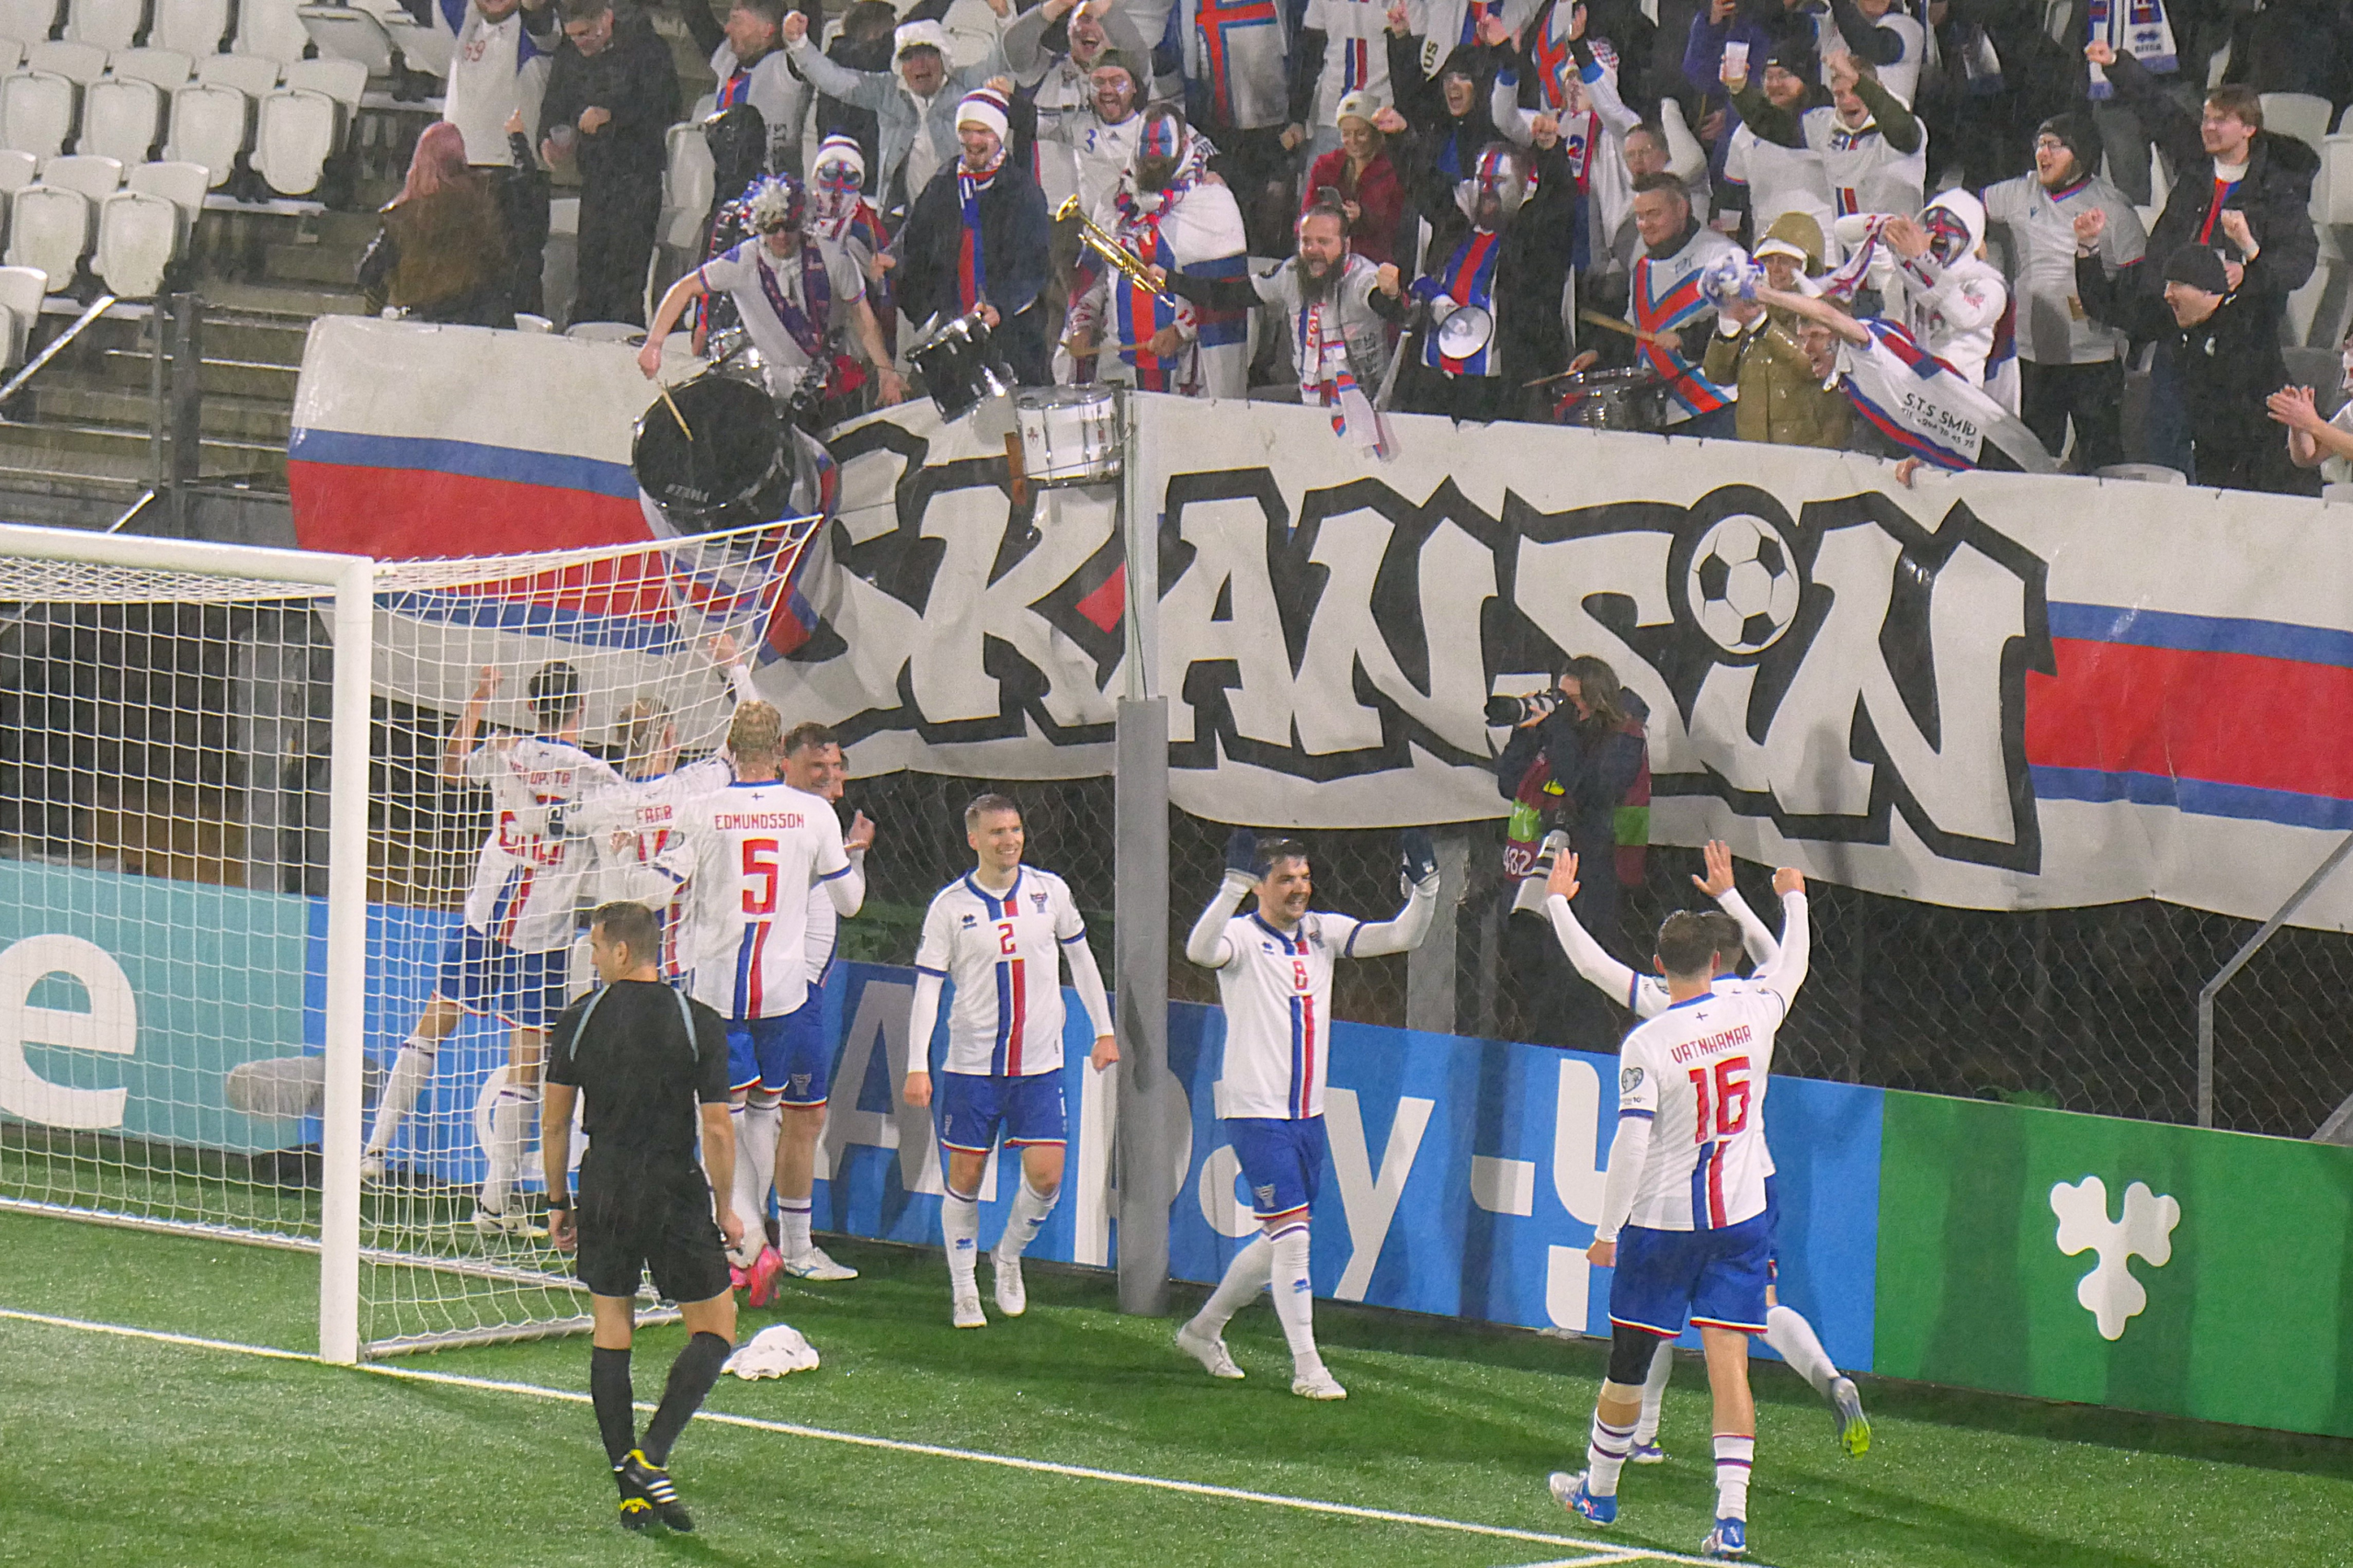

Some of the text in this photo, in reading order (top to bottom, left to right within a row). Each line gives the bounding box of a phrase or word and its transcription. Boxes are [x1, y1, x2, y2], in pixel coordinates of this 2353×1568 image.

[1086, 129, 1097, 154] 3
[715, 813, 804, 830] EDMUNDSSON
[742, 838, 779, 915] 5
[1503, 846, 1533, 876] 482
[998, 923, 1017, 955] 2
[1293, 960, 1309, 991] 8
[1671, 1025, 1753, 1064] VATNHAMAR
[1688, 1056, 1751, 1145] 16
